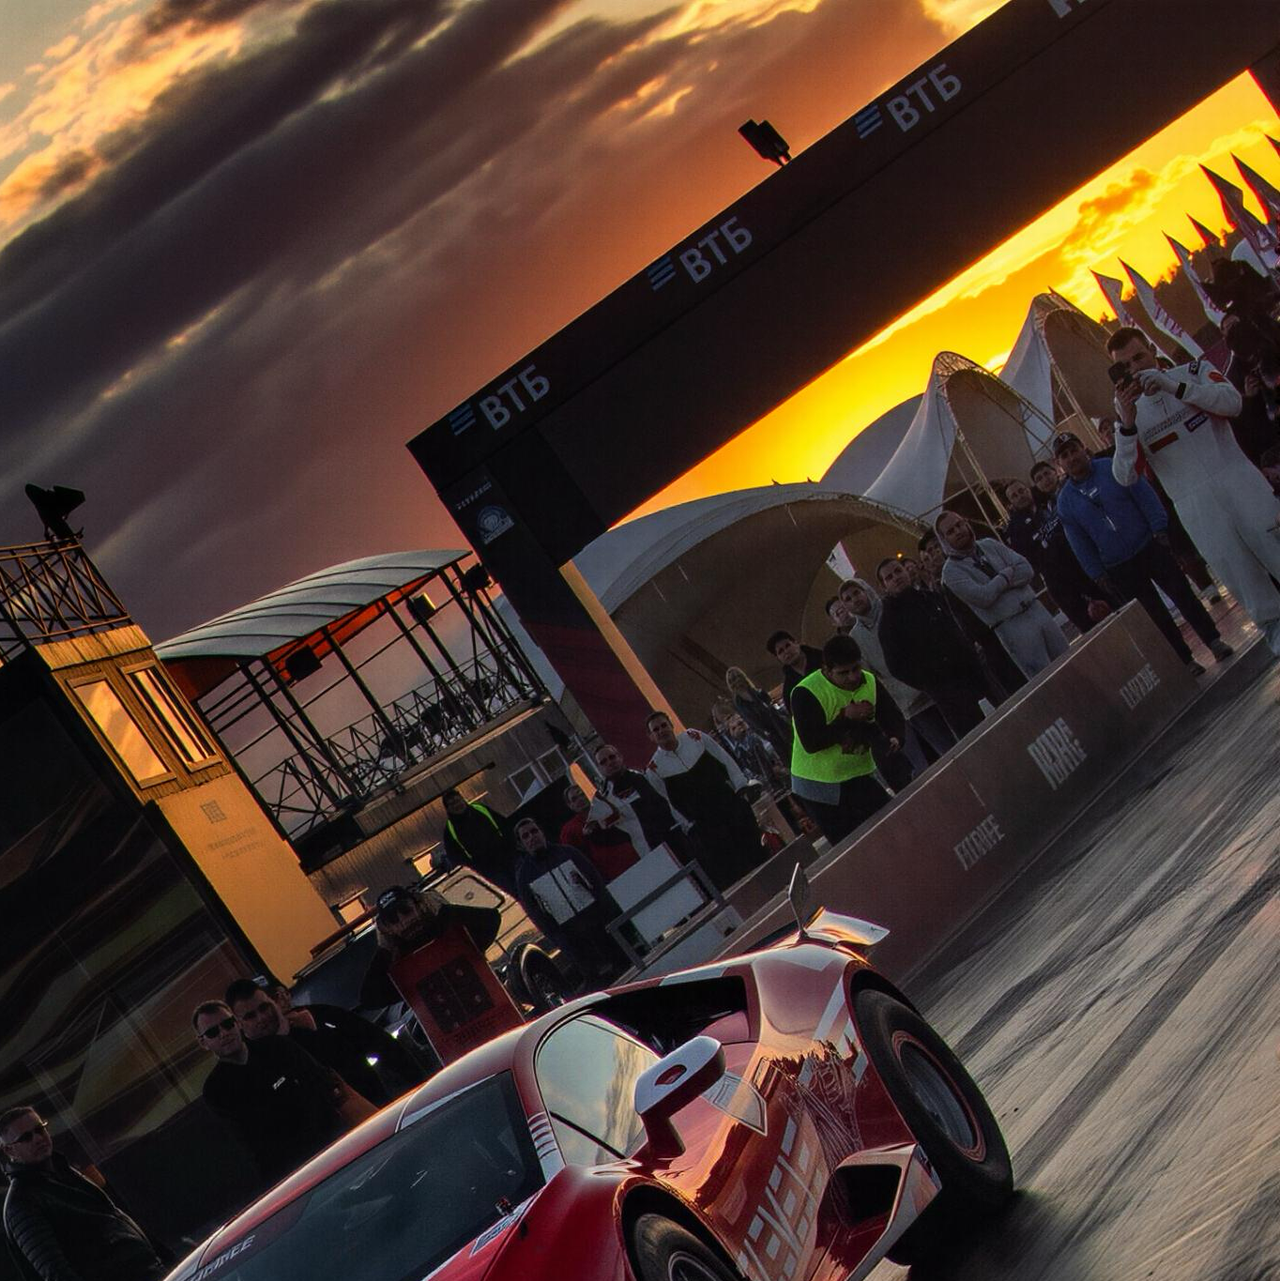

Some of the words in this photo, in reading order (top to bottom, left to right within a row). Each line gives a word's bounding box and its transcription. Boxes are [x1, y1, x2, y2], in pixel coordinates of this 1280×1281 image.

[885, 63, 963, 133] ВТБ
[679, 216, 753, 284] ВТБ
[478, 364, 551, 431] ВТБ
